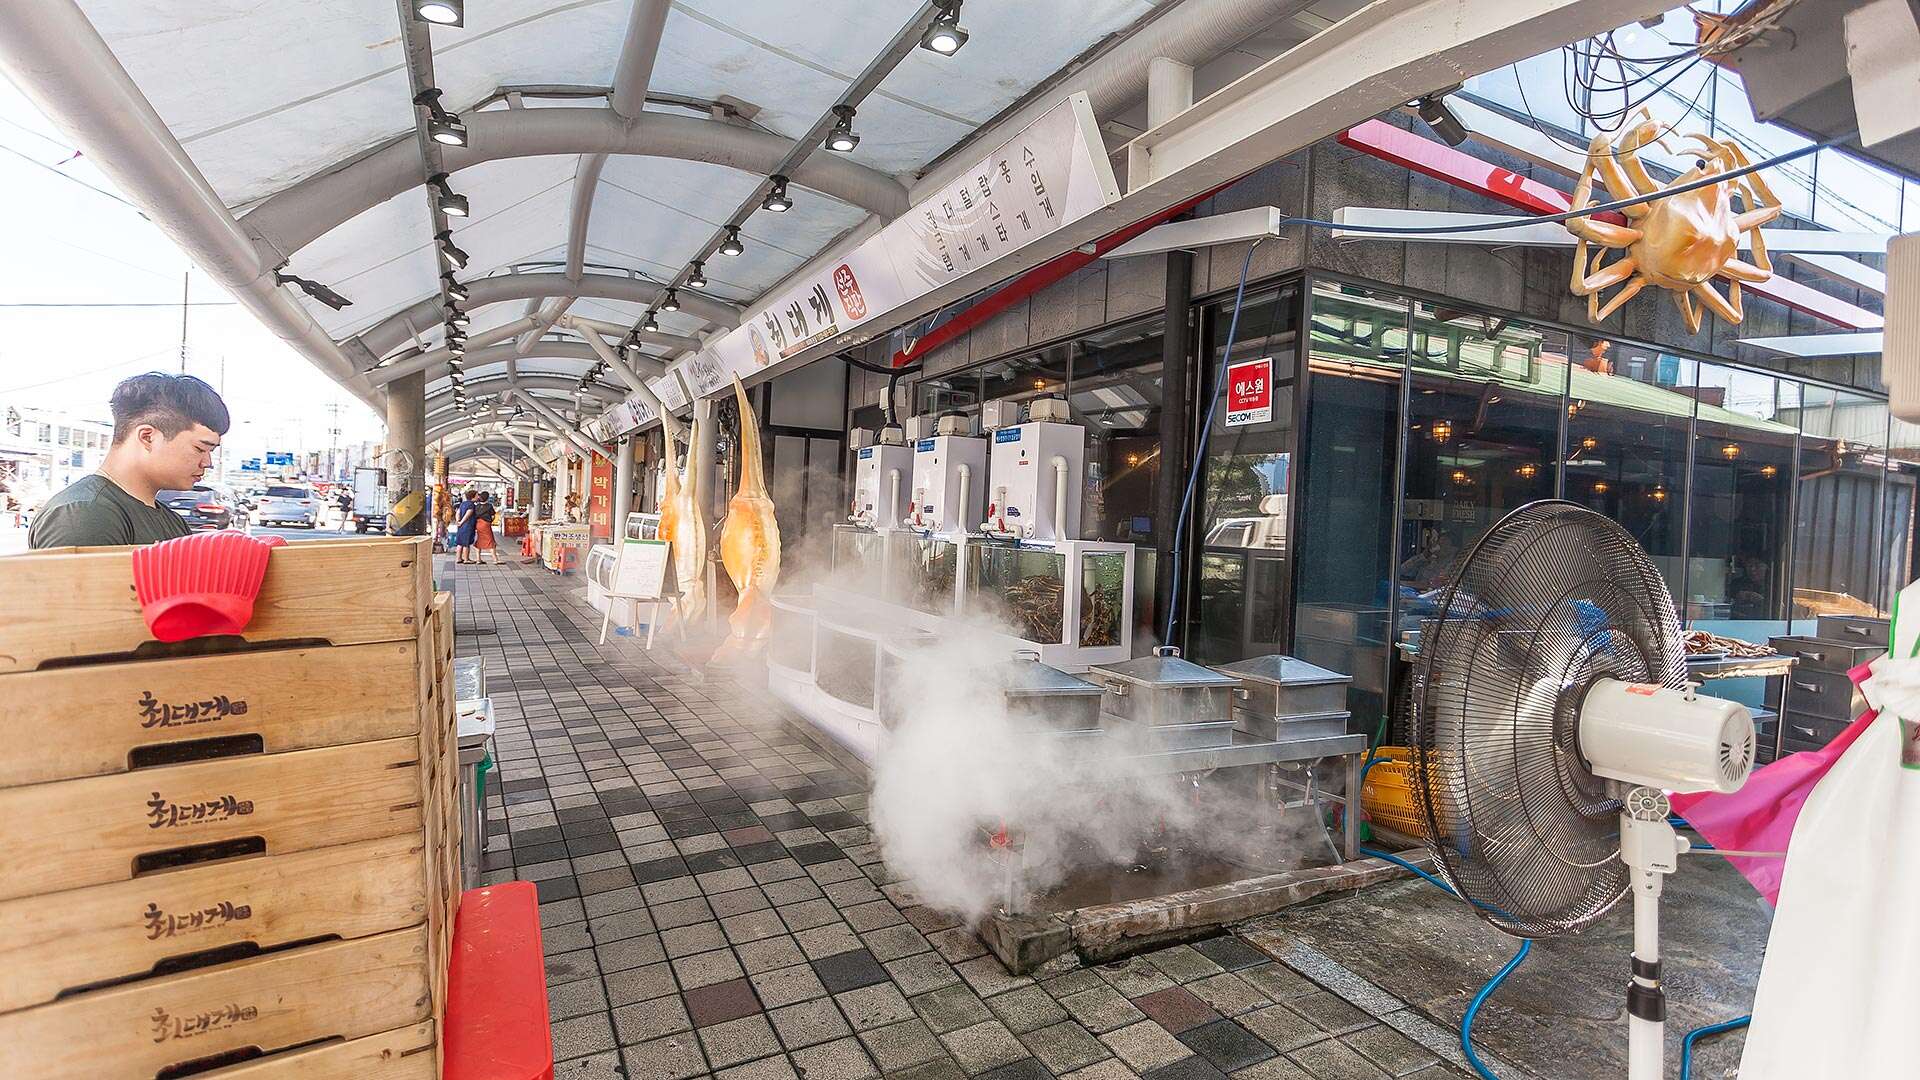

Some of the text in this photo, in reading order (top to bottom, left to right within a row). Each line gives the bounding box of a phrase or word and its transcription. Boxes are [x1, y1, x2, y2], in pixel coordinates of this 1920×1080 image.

[977, 173, 1010, 243] 랍스타
[998, 159, 1031, 231] 홍게
[1023, 146, 1055, 218] 수입게
[925, 209, 955, 273] 킹크랩
[942, 198, 972, 262] 대게
[959, 186, 990, 253] 털게
[763, 282, 836, 349] 최대게
[1235, 378, 1263, 396] 에스원
[1228, 412, 1252, 424] SECOM
[593, 476, 609, 526] 박가네
[138, 690, 232, 728] 최대게
[146, 791, 238, 829] 최대게
[144, 902, 235, 941] 최대게
[151, 1006, 242, 1044] 최대게
